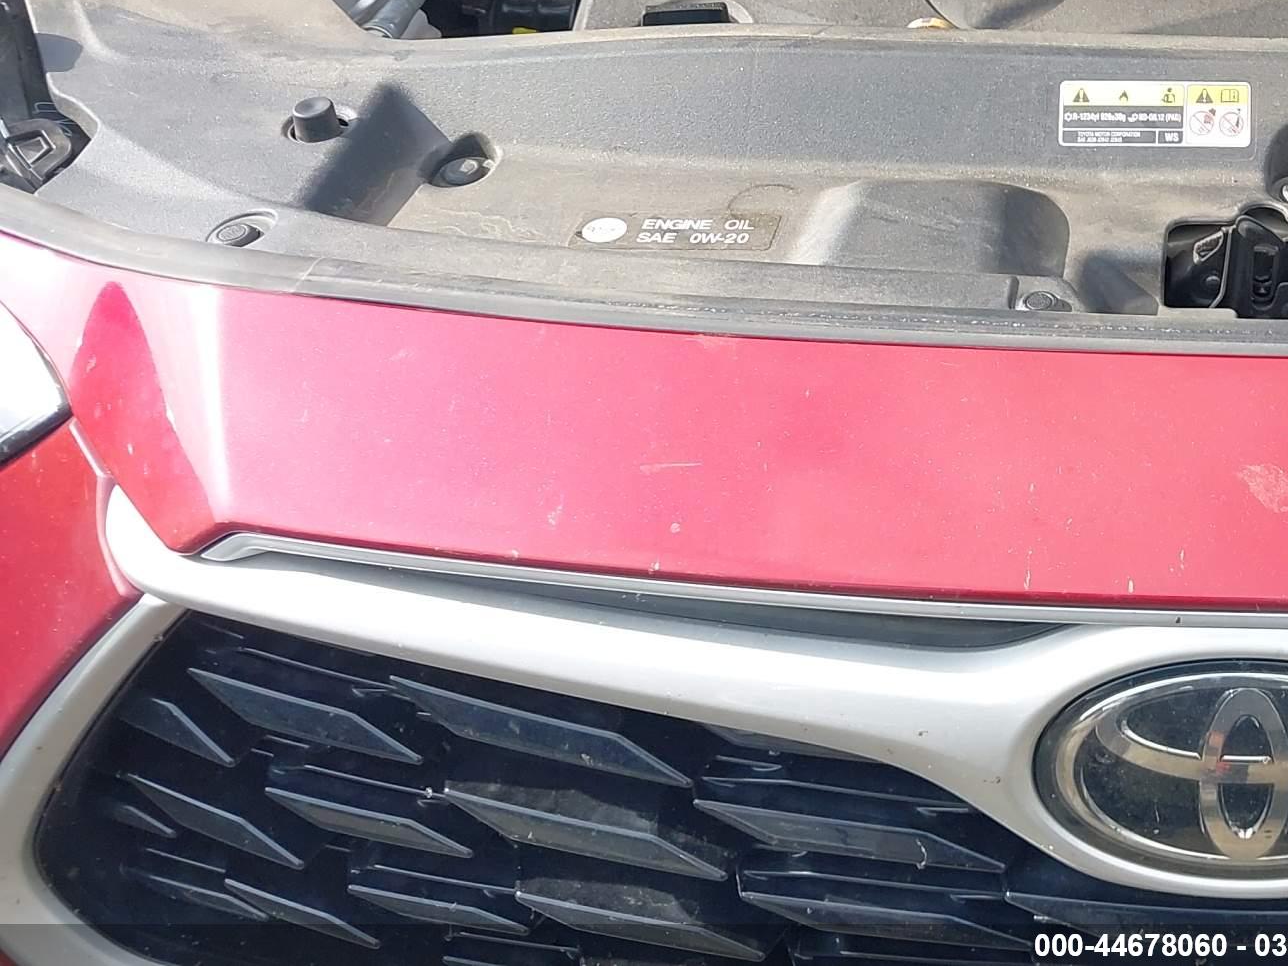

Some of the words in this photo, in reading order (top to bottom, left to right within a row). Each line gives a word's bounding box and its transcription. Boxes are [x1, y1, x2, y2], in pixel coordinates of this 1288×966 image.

[641, 219, 713, 230] ENGINE
[724, 219, 755, 231] OIL
[636, 232, 676, 243] SAE
[690, 233, 750, 244] 0W-20
